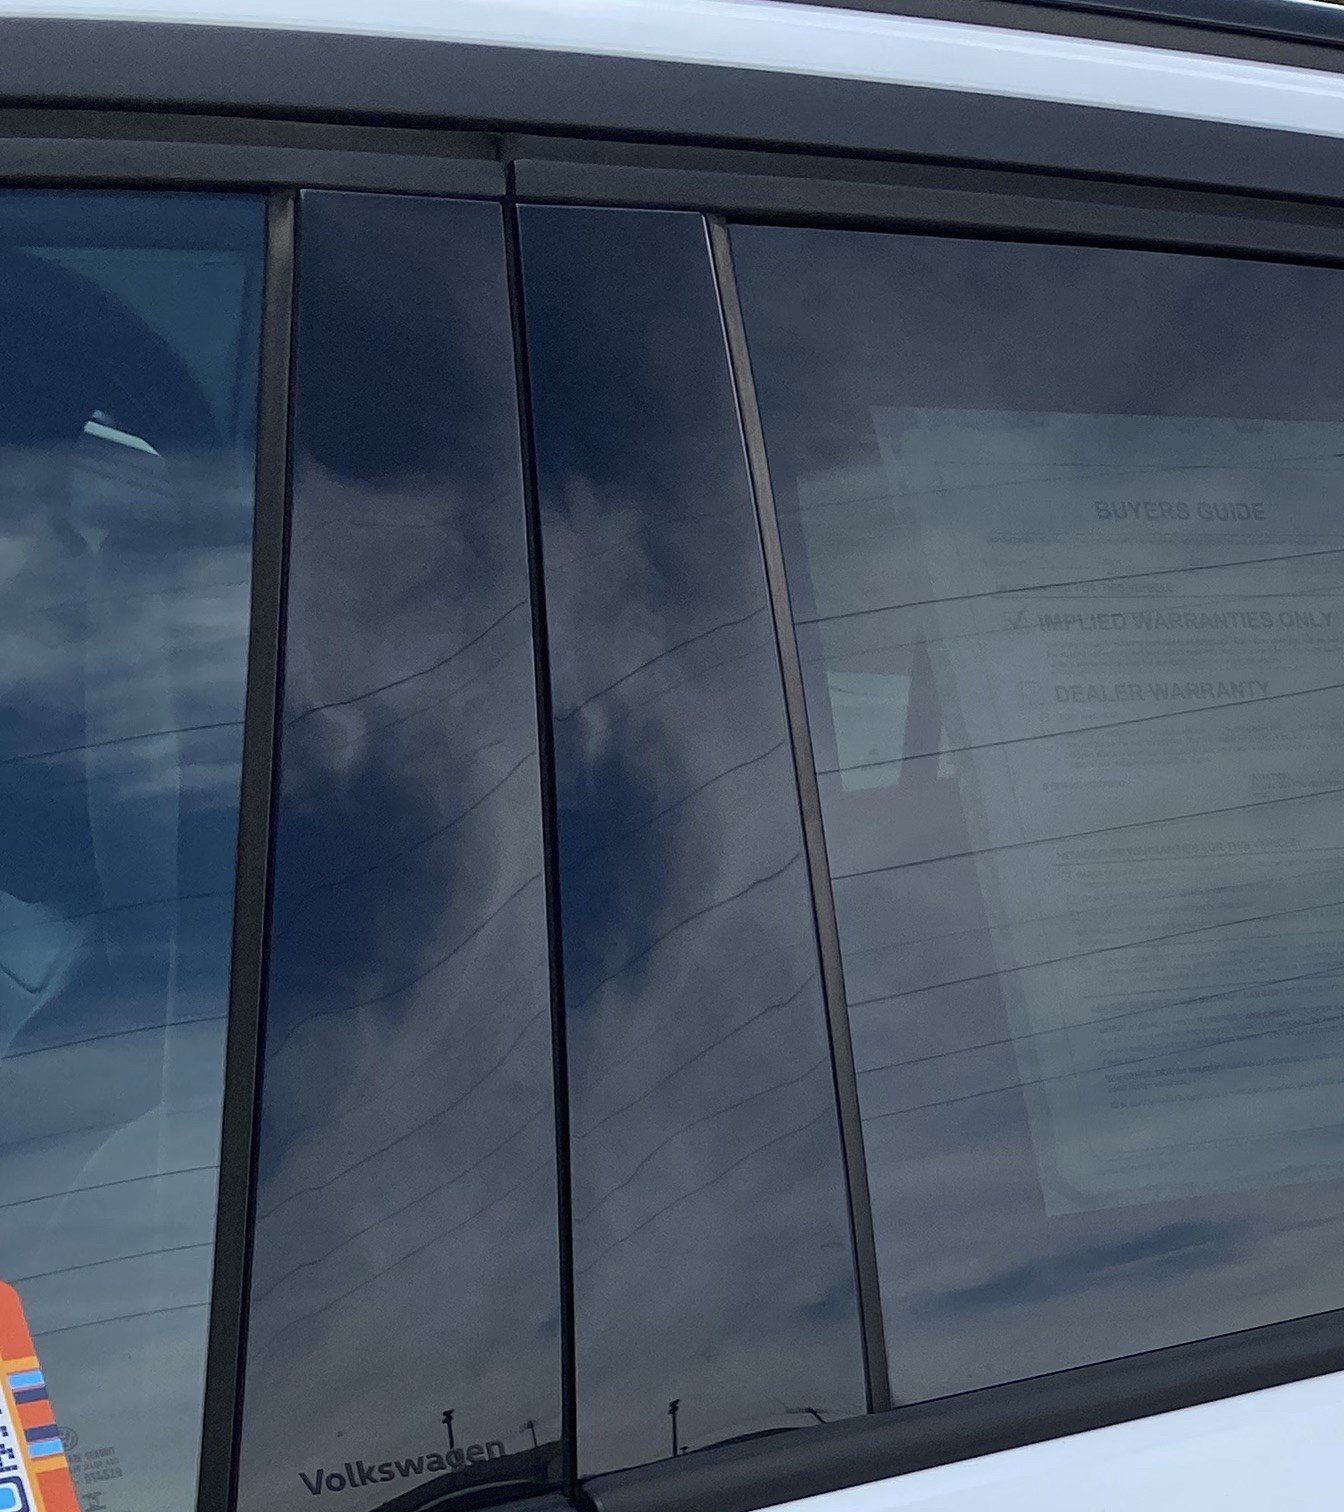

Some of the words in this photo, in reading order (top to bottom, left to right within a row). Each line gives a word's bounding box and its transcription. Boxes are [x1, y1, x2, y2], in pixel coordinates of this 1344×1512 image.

[1094, 500, 1191, 522] BUYERS
[1197, 501, 1267, 522] GUIDE
[1038, 612, 1127, 632] IMPLIED
[1133, 610, 1274, 632] WARRANTIES
[1279, 610, 1335, 629] ONLY
[1054, 683, 1146, 704] DEALER
[1149, 679, 1271, 702] WARRANTY
[298, 1439, 507, 1496] Volkswagen
